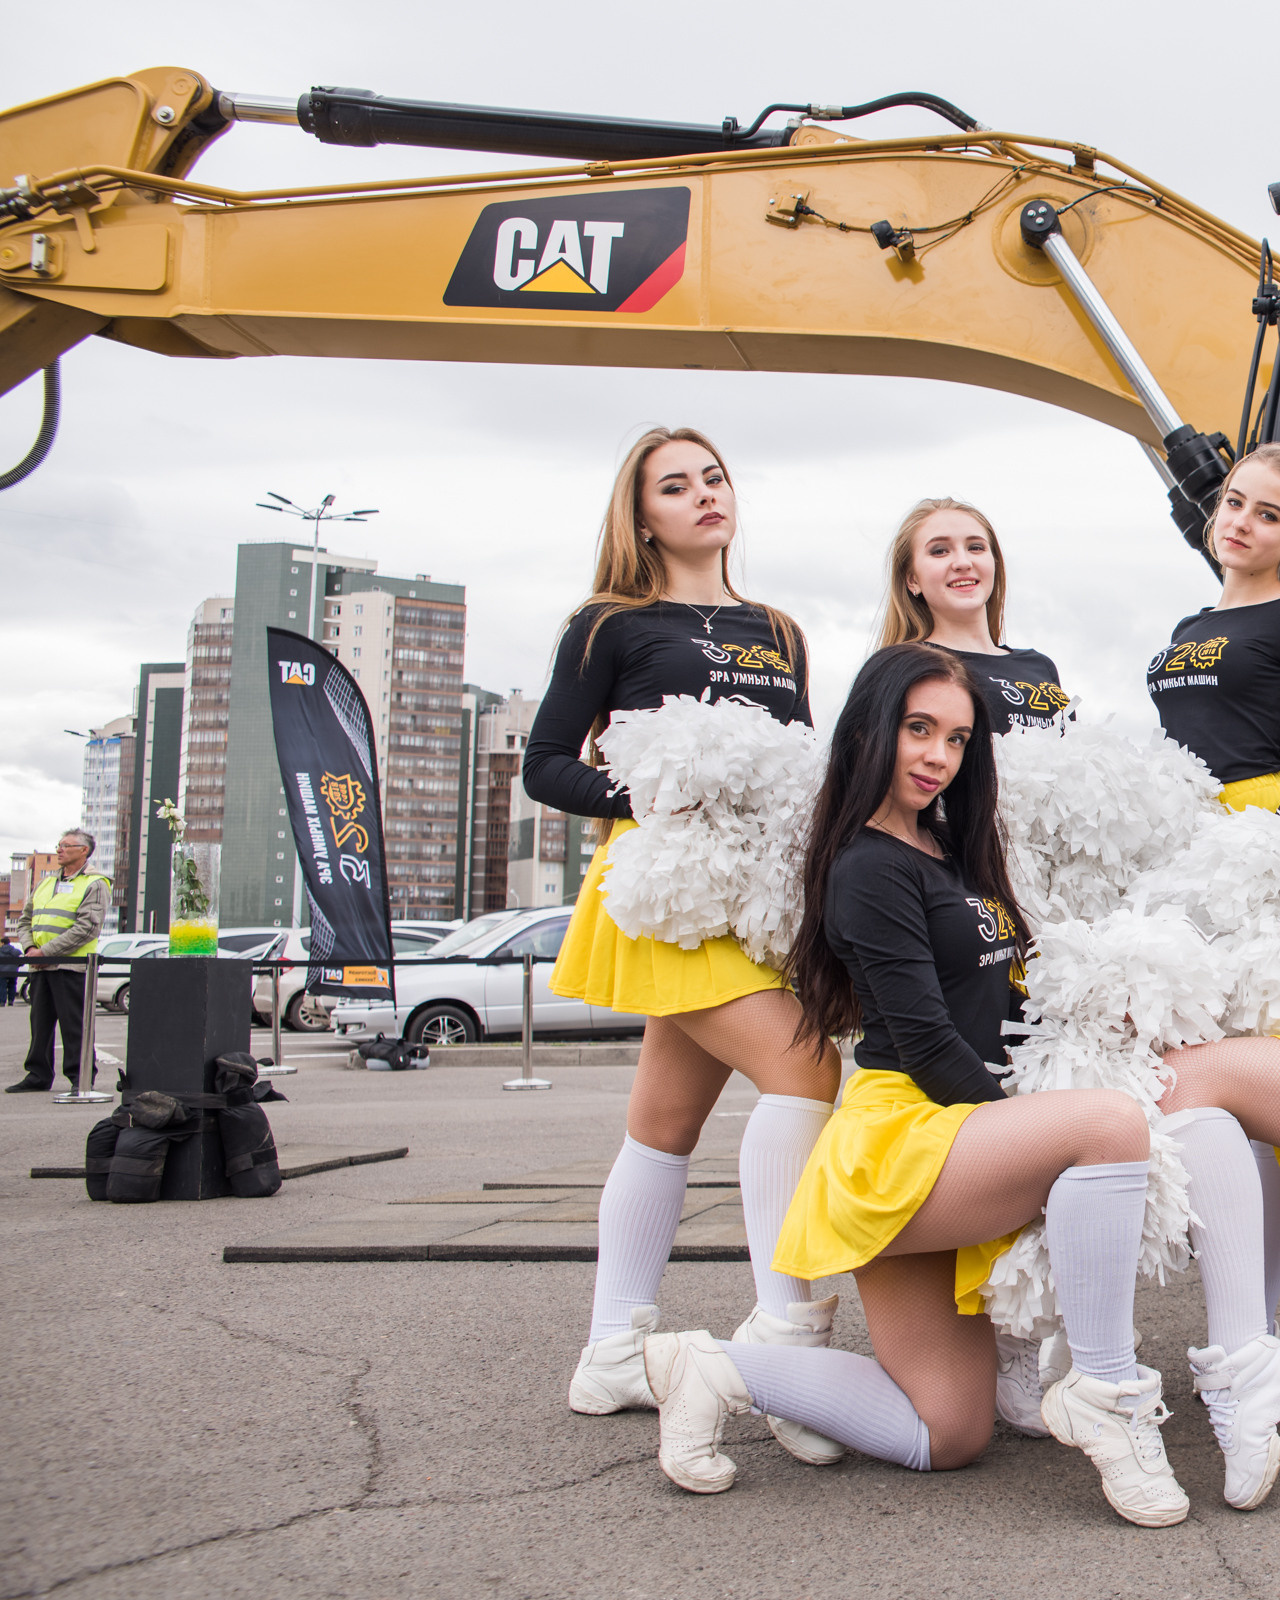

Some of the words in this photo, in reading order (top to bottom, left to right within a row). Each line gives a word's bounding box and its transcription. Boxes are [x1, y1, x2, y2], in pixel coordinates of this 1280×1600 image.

[493, 217, 625, 295] CAT
[709, 670, 730, 683] ЭРА
[731, 671, 771, 687] УМНЫХ
[1157, 676, 1187, 692] УМНЫХ
[1187, 674, 1219, 686] МАШИН
